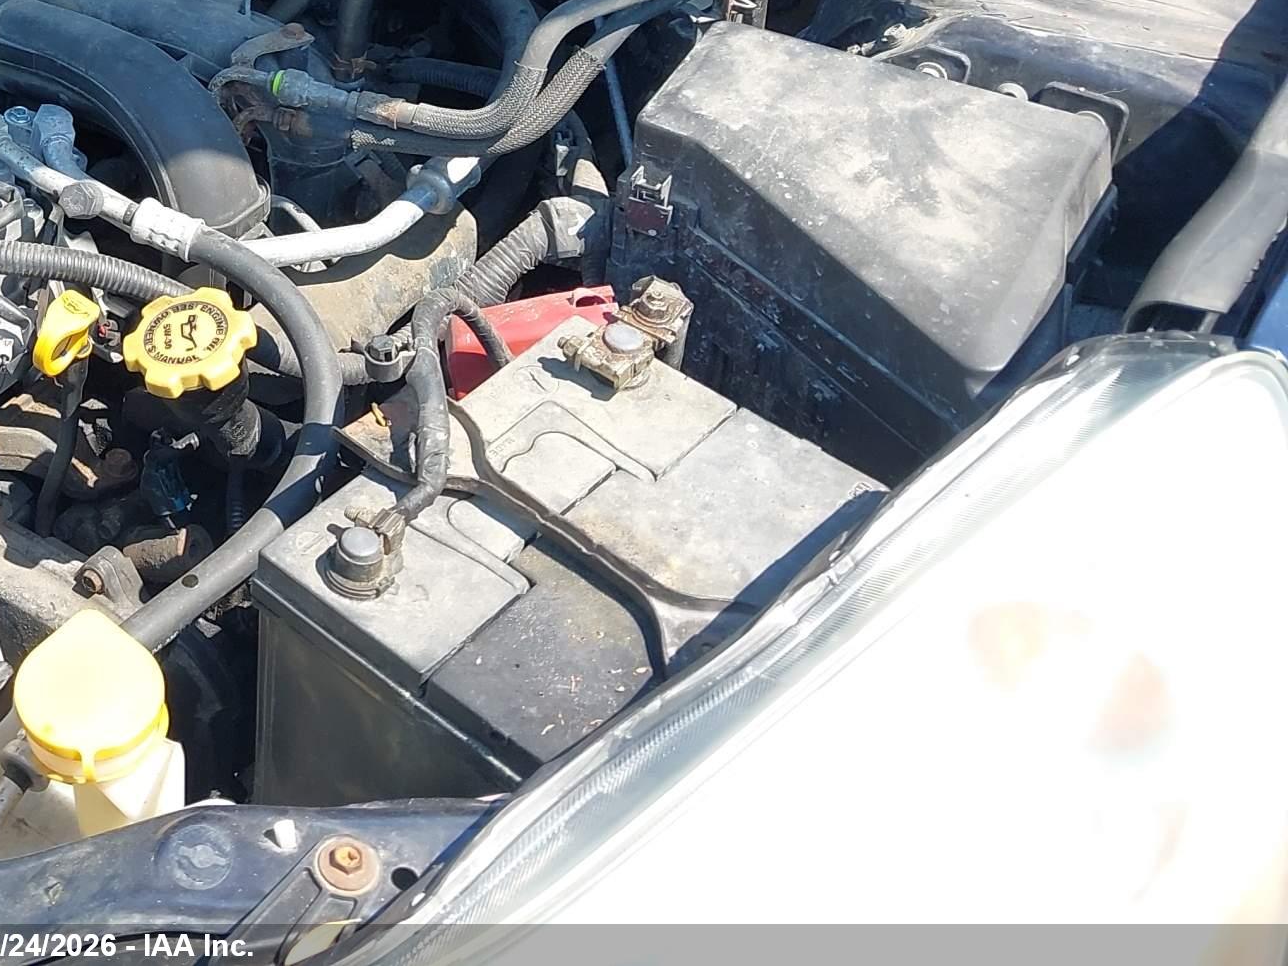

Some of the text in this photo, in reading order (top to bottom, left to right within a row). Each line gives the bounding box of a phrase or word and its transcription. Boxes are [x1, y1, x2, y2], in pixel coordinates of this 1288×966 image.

[172, 303, 194, 314] SEE
[199, 304, 225, 335] ENGINE
[163, 323, 173, 350] 5W-30
[152, 351, 201, 365] MANUAL
